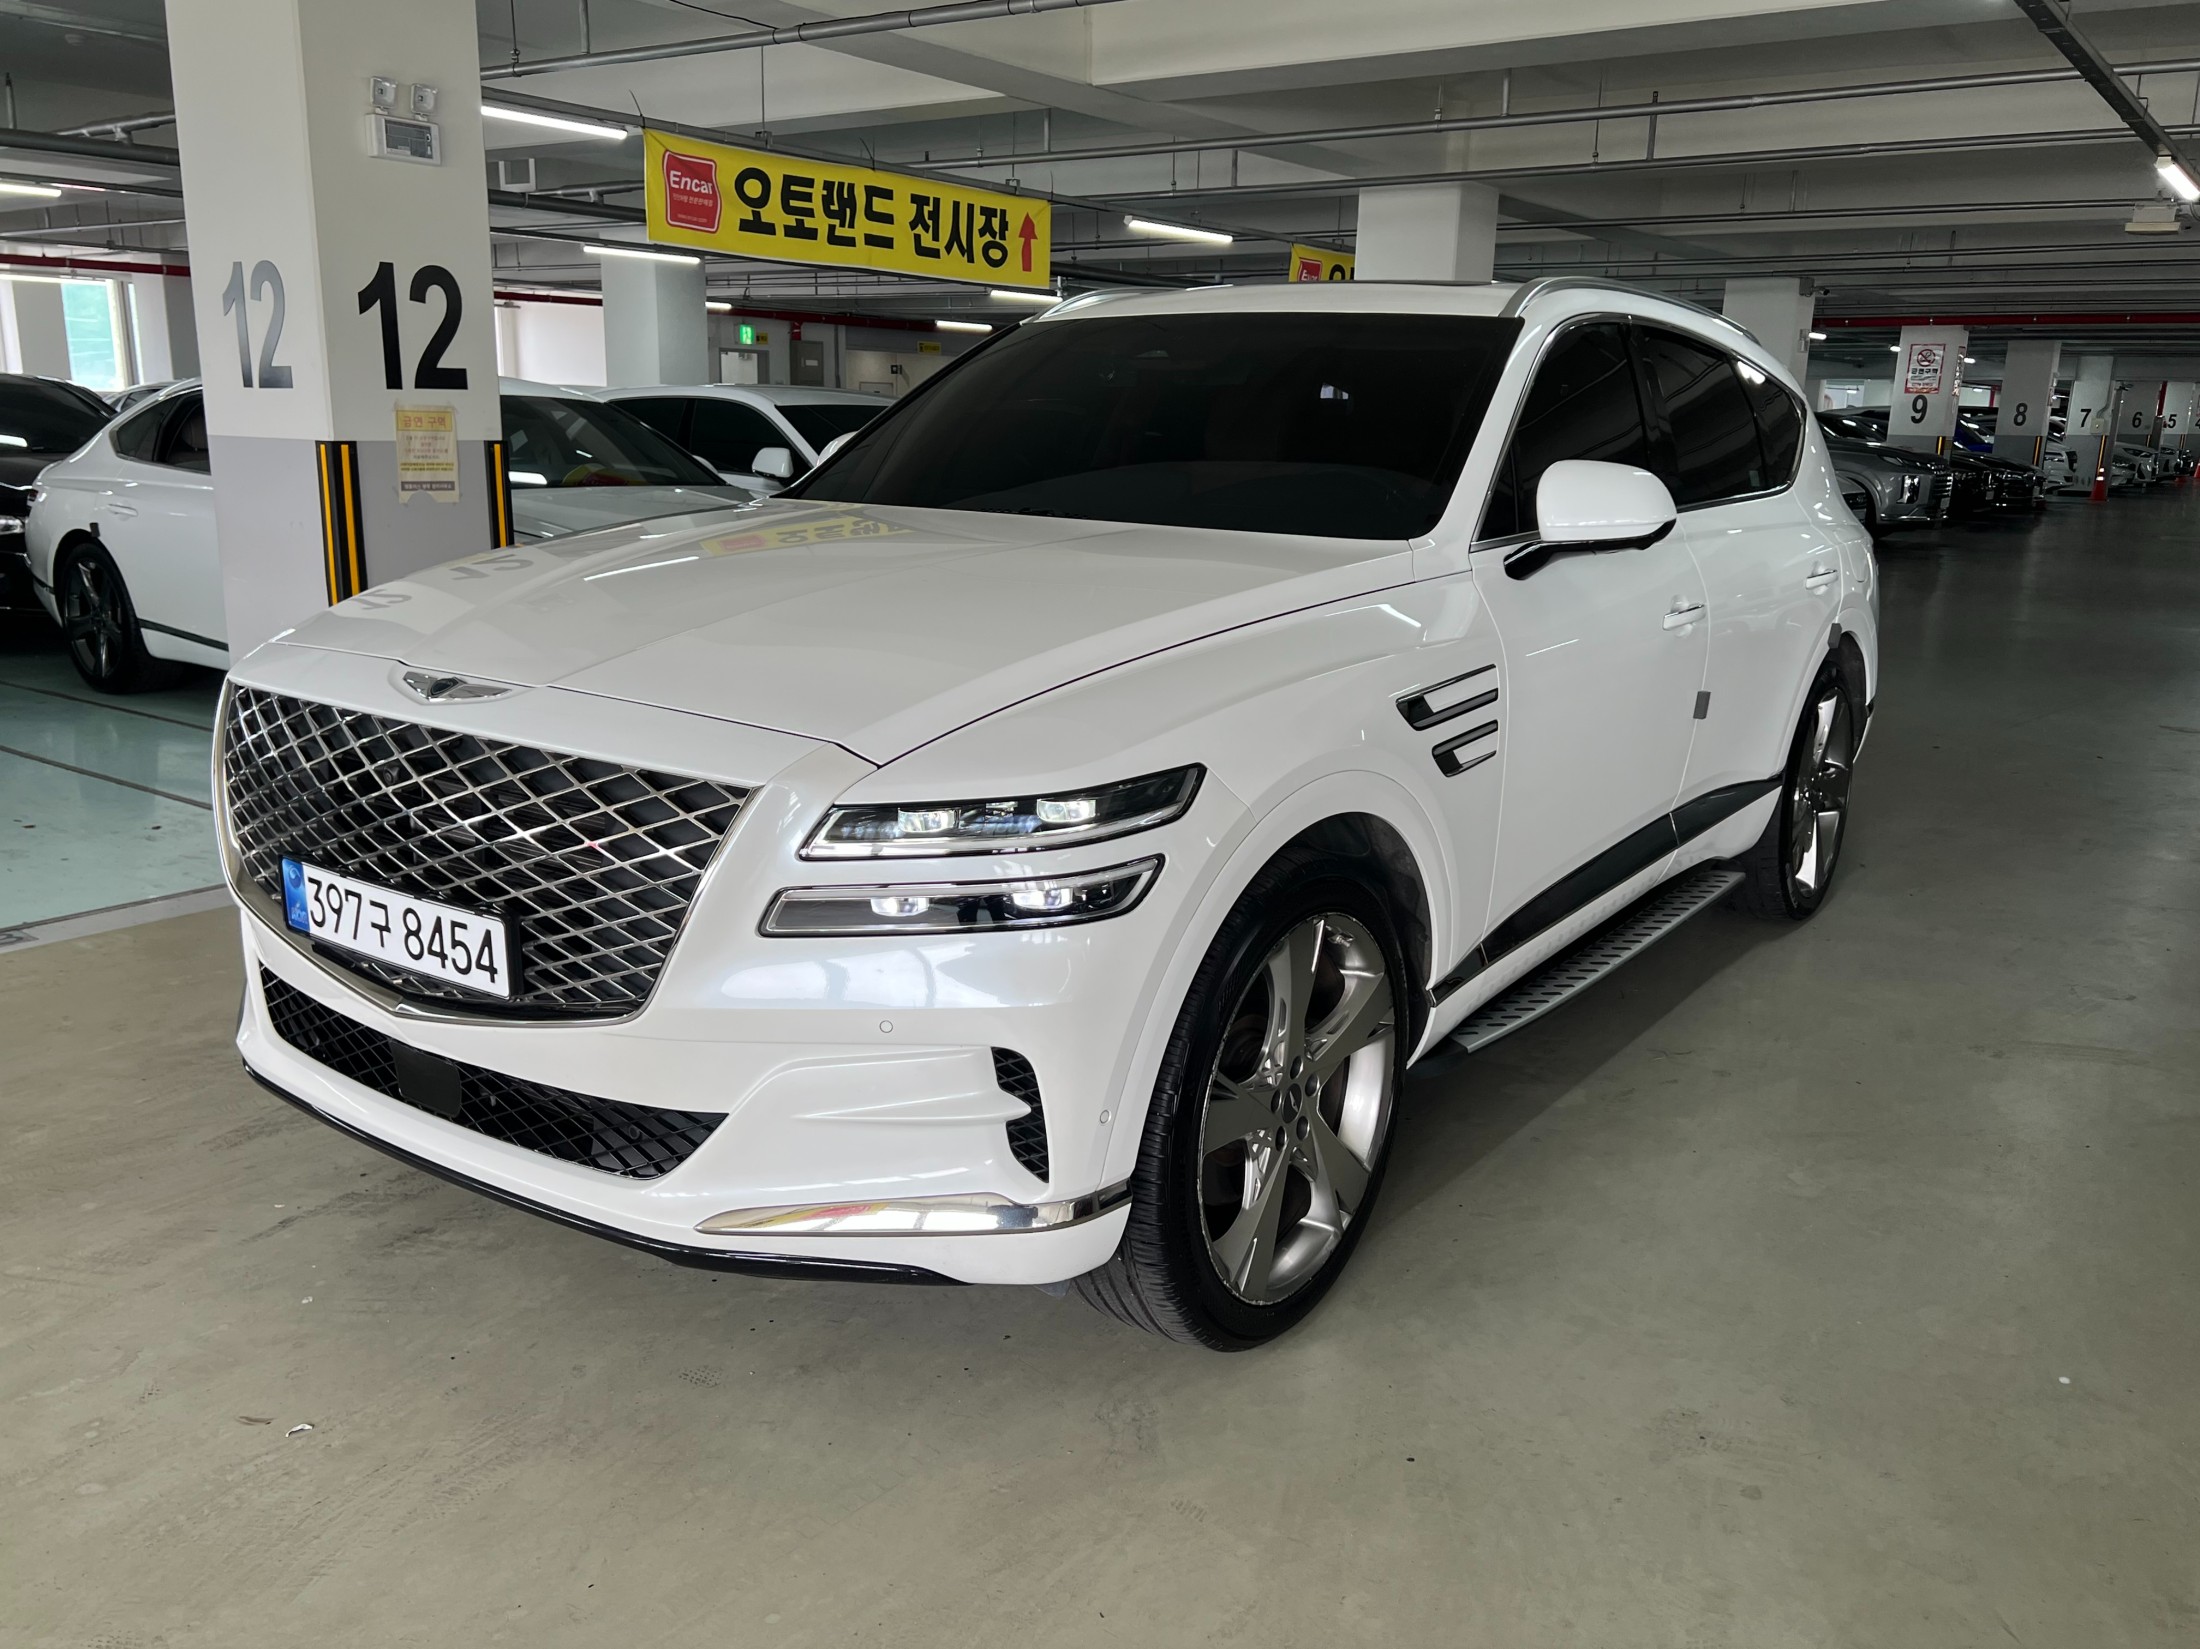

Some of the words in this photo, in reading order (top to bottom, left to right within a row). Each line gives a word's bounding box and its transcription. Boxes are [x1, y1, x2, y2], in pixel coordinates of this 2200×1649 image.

[669, 169, 714, 195] Encar
[734, 166, 895, 251] 오토랜드
[909, 192, 1010, 269] 전시장
[222, 260, 294, 389] 12
[358, 261, 469, 390] 12
[403, 415, 424, 428] 금연
[427, 415, 447, 429] 구역
[1910, 394, 1928, 424] 9
[2013, 402, 2028, 427] 8
[2080, 408, 2092, 428] 7
[2131, 411, 2143, 429] 6
[2167, 413, 2178, 429] 5
[307, 876, 392, 949] 397구
[402, 907, 498, 984] 8454
